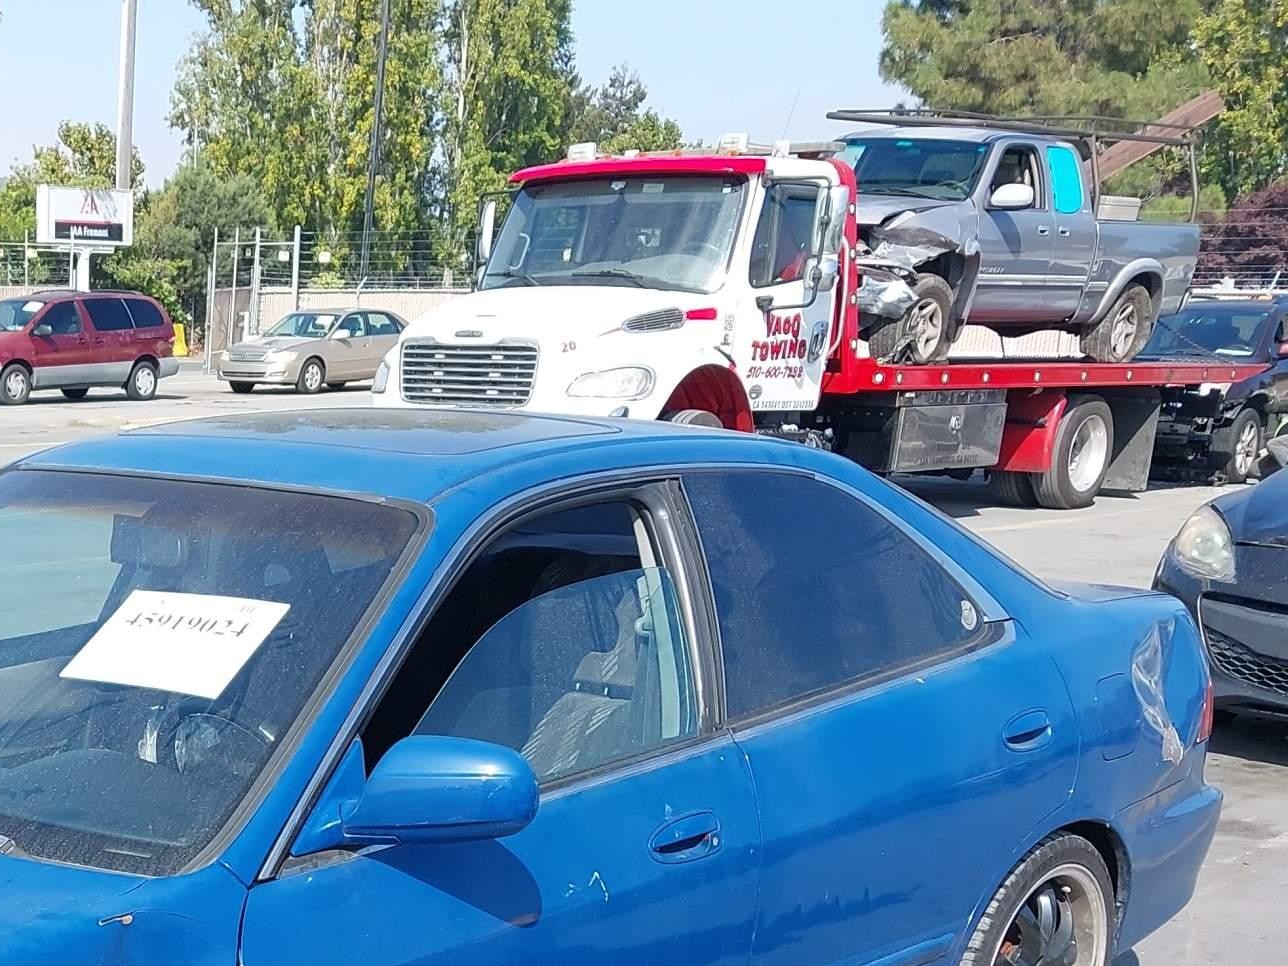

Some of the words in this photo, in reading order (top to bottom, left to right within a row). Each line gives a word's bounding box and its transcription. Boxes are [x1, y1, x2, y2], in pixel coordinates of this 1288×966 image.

[84, 225, 109, 237] Fremont
[561, 341, 577, 353] 20
[751, 339, 807, 361] TOWING
